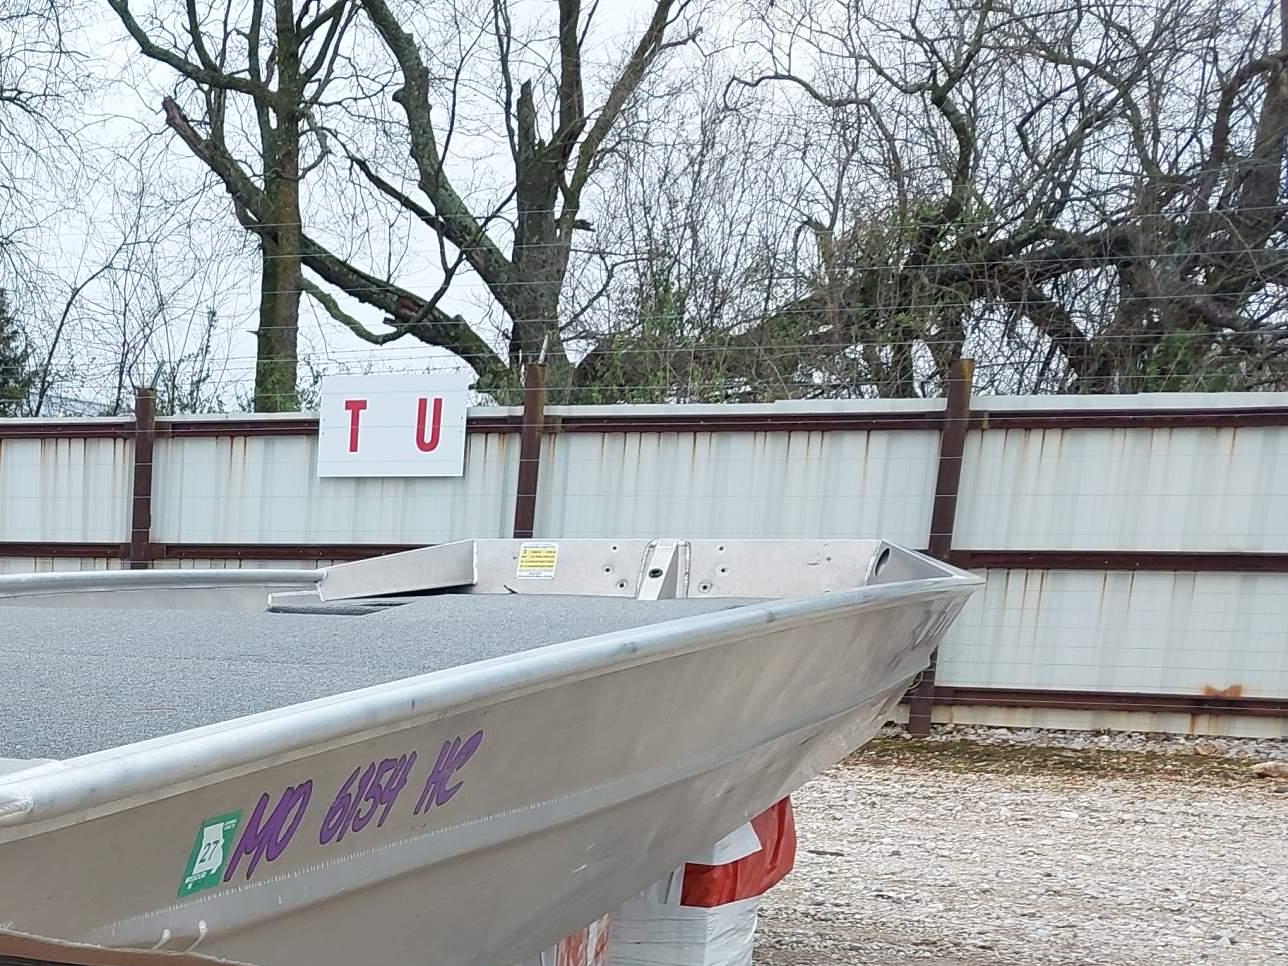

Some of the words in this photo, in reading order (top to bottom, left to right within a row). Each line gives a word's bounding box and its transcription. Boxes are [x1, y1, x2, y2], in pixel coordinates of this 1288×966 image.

[344, 400, 368, 453] T
[415, 398, 443, 453] U
[222, 778, 313, 882] MO
[319, 750, 418, 845] 6154
[413, 729, 484, 815] HC
[198, 839, 220, 864] 27
